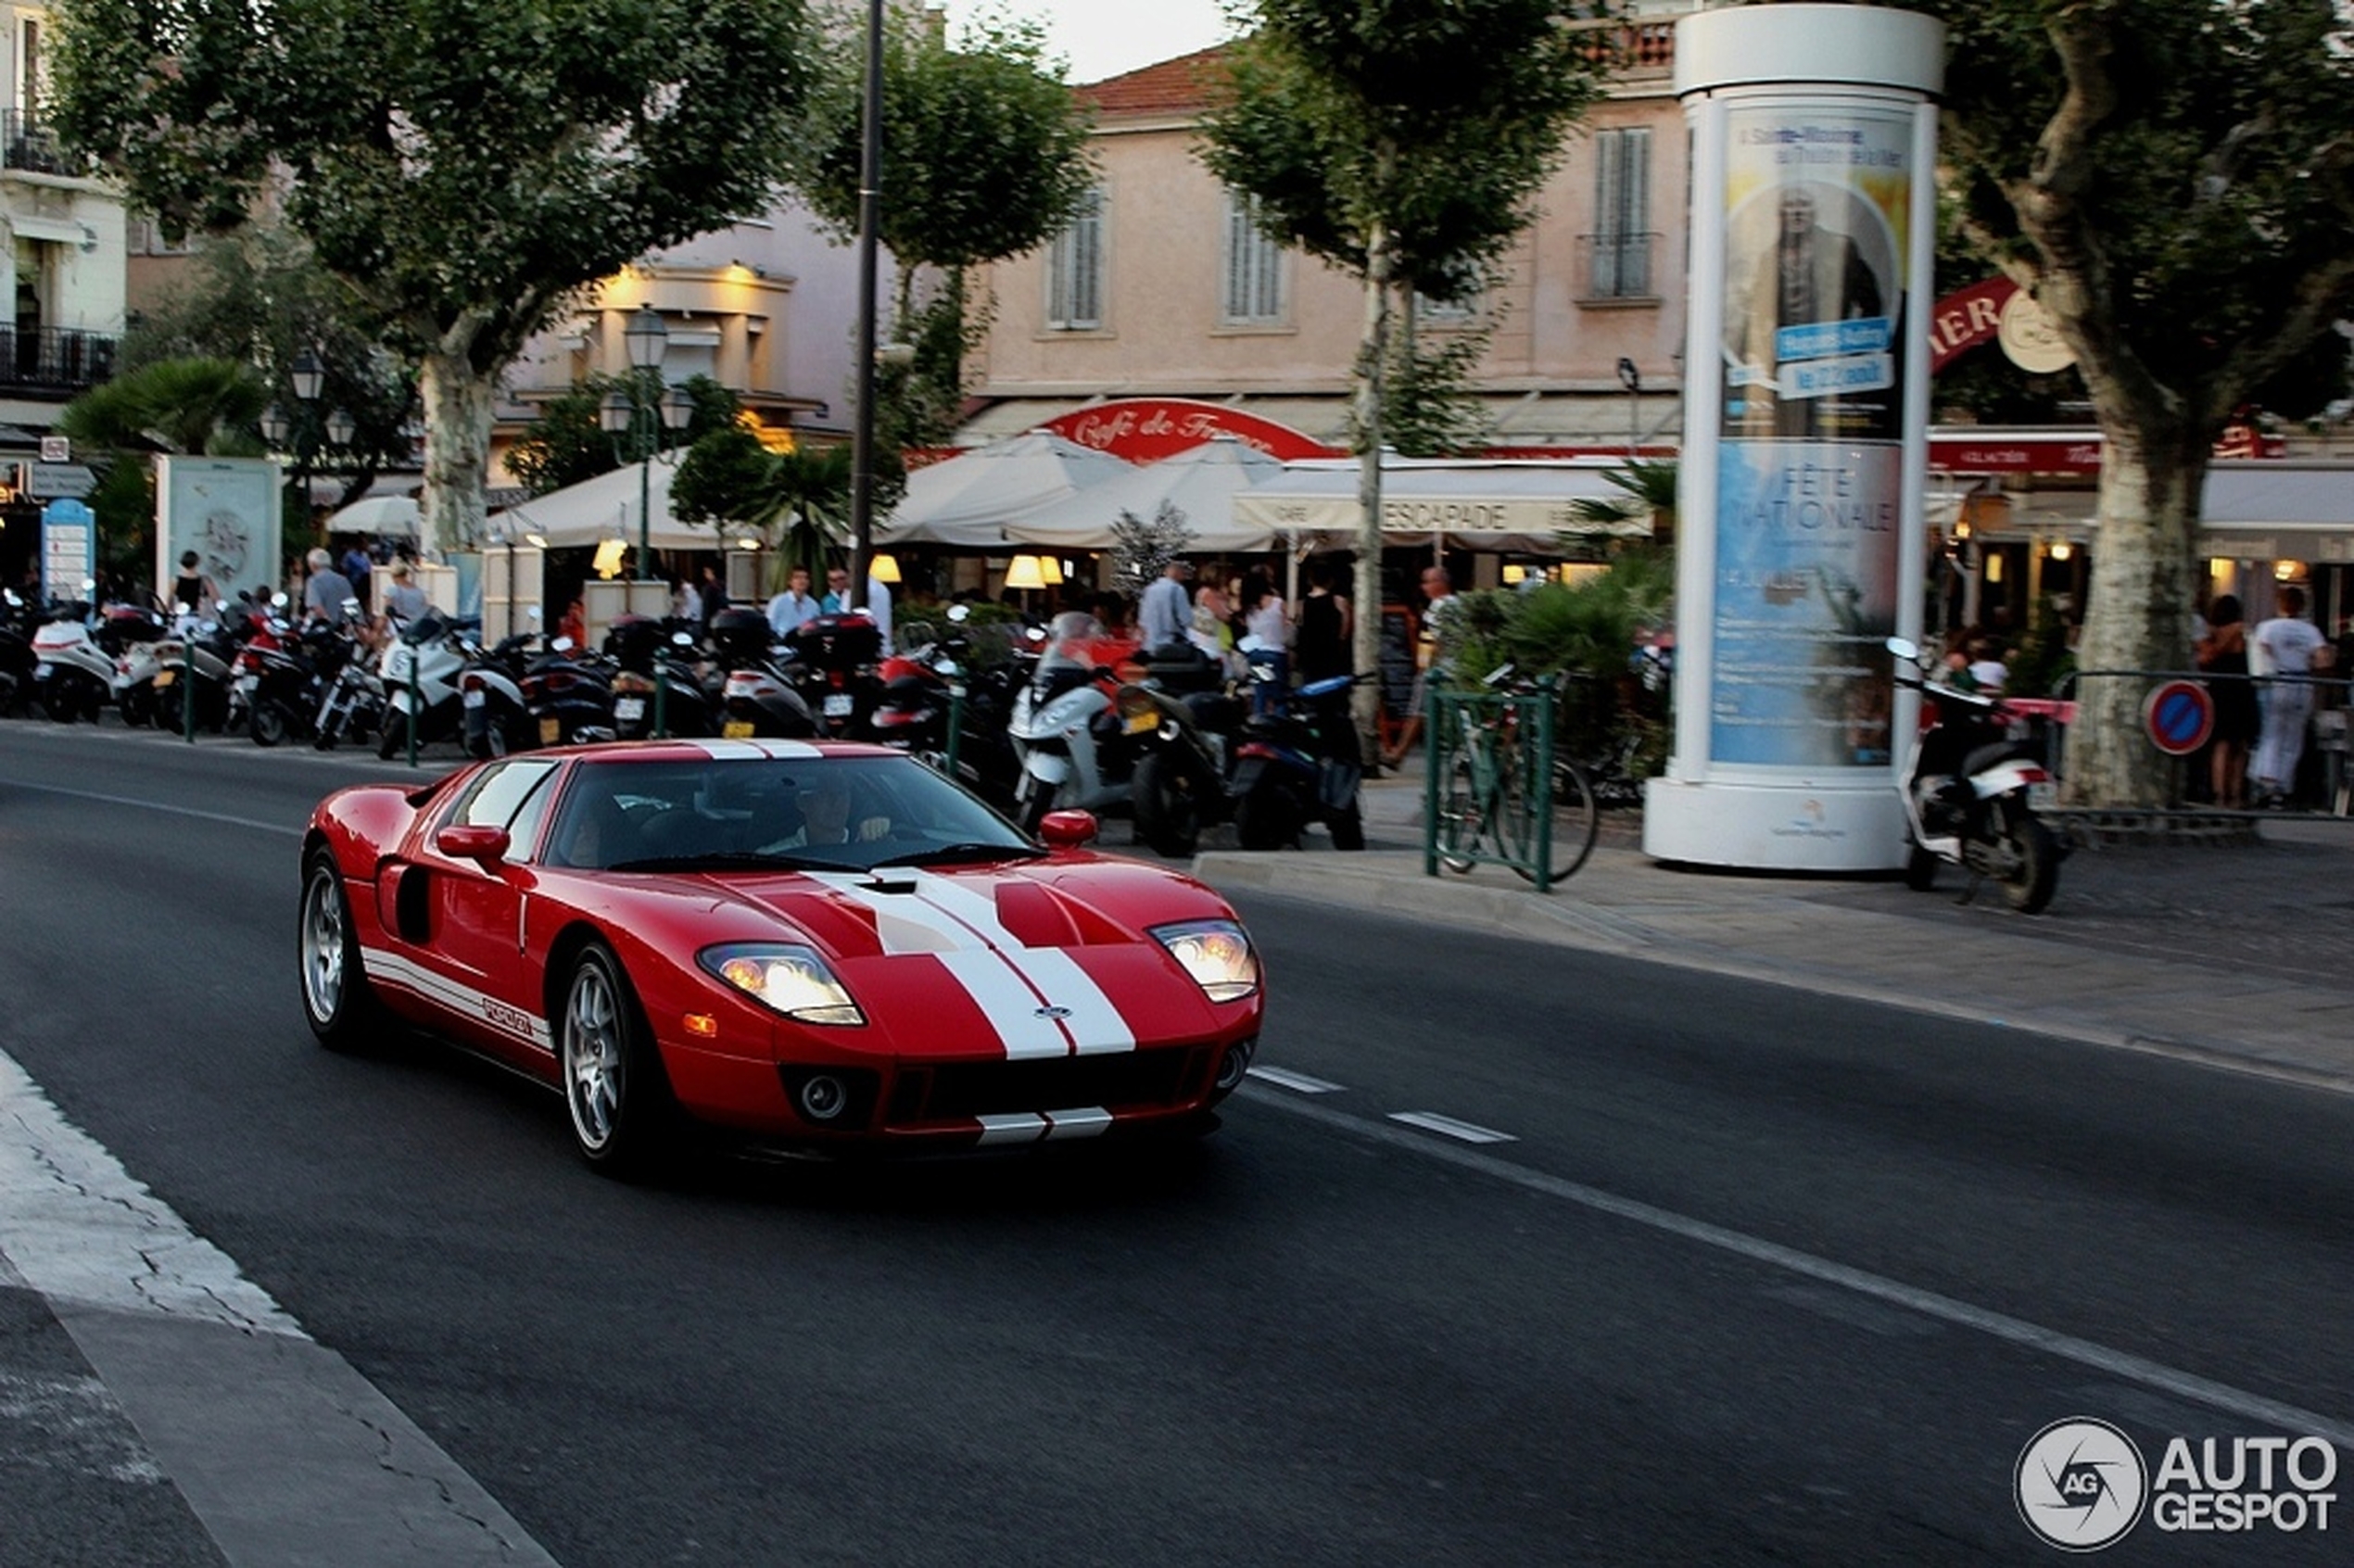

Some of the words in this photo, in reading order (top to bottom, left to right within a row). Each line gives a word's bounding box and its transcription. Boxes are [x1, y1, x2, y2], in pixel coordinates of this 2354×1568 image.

[1139, 409, 1174, 436] de
[1785, 462, 1850, 498] FÊTE
[1382, 503, 1506, 529] ESCAPADE
[1731, 499, 1892, 531] NATIONALE
